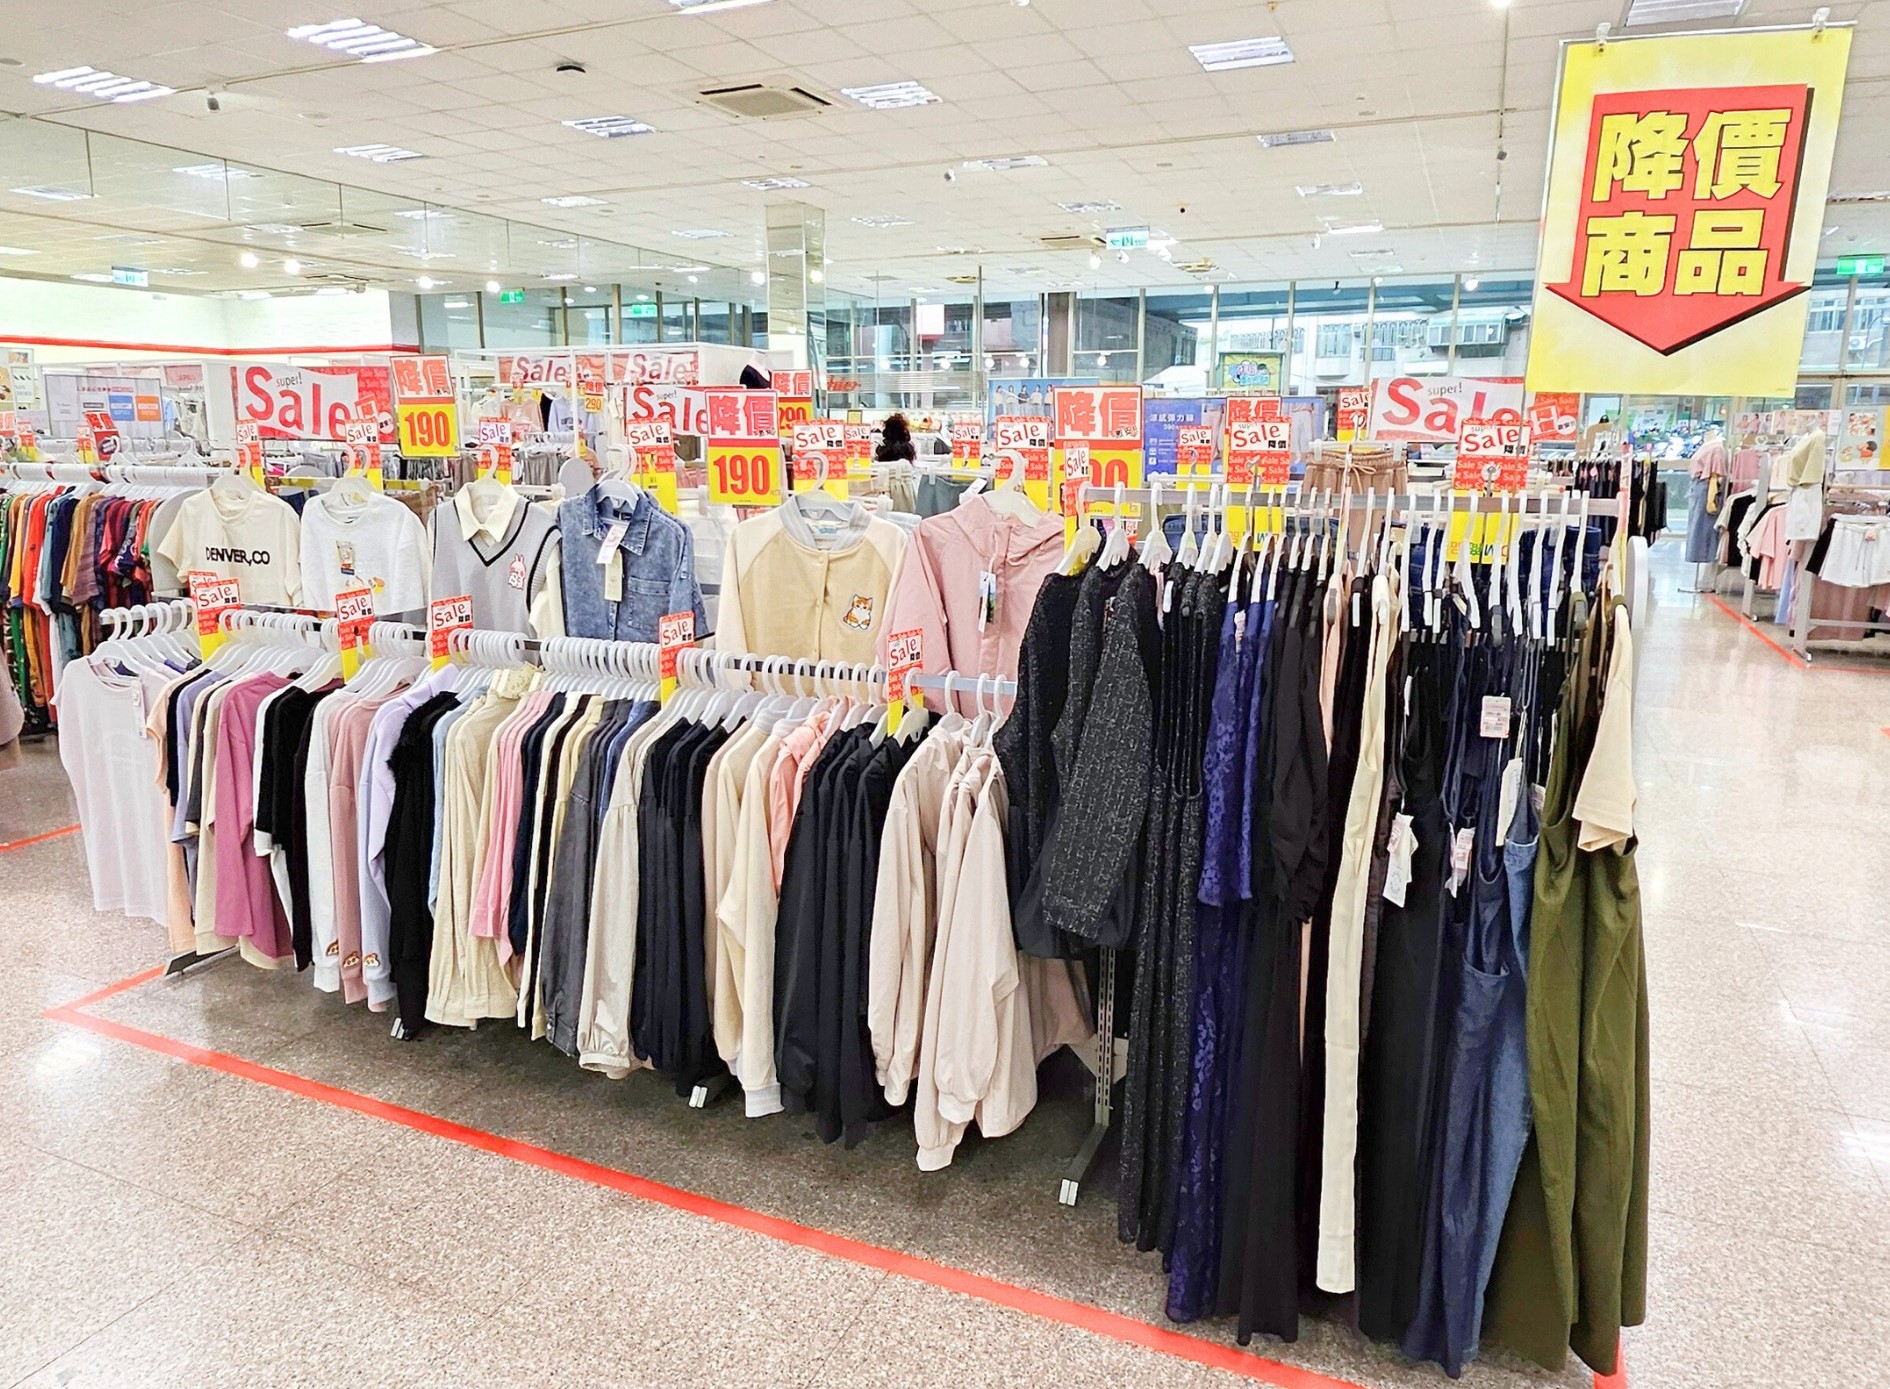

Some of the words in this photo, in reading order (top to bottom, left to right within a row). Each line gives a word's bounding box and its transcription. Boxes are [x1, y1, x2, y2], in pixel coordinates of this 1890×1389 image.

[1592, 108, 1793, 203] 降價
[1579, 209, 1769, 298] 商品
[276, 372, 302, 387] super!
[393, 359, 453, 395] 降價
[517, 356, 567, 382] Sale
[1427, 382, 1462, 397] super!
[245, 366, 348, 441] Sale
[708, 395, 775, 436] 降價
[1057, 391, 1139, 437] 降價
[347, 423, 373, 443] Sale
[405, 411, 450, 447] 190
[482, 424, 506, 442] Sale
[630, 425, 664, 445] Sale
[796, 427, 836, 447] Sale
[956, 427, 976, 440] Sale
[1000, 424, 1040, 446] Sale
[1181, 430, 1207, 444] Sale
[1233, 424, 1281, 447] Sale
[1464, 427, 1519, 452] Sale
[713, 455, 770, 495] 190
[1067, 450, 1086, 476] Sale
[199, 586, 232, 607] Sale
[341, 597, 367, 620] Sale
[435, 604, 466, 627] Sale
[663, 621, 688, 646] Sale
[891, 639, 917, 667] Sale
